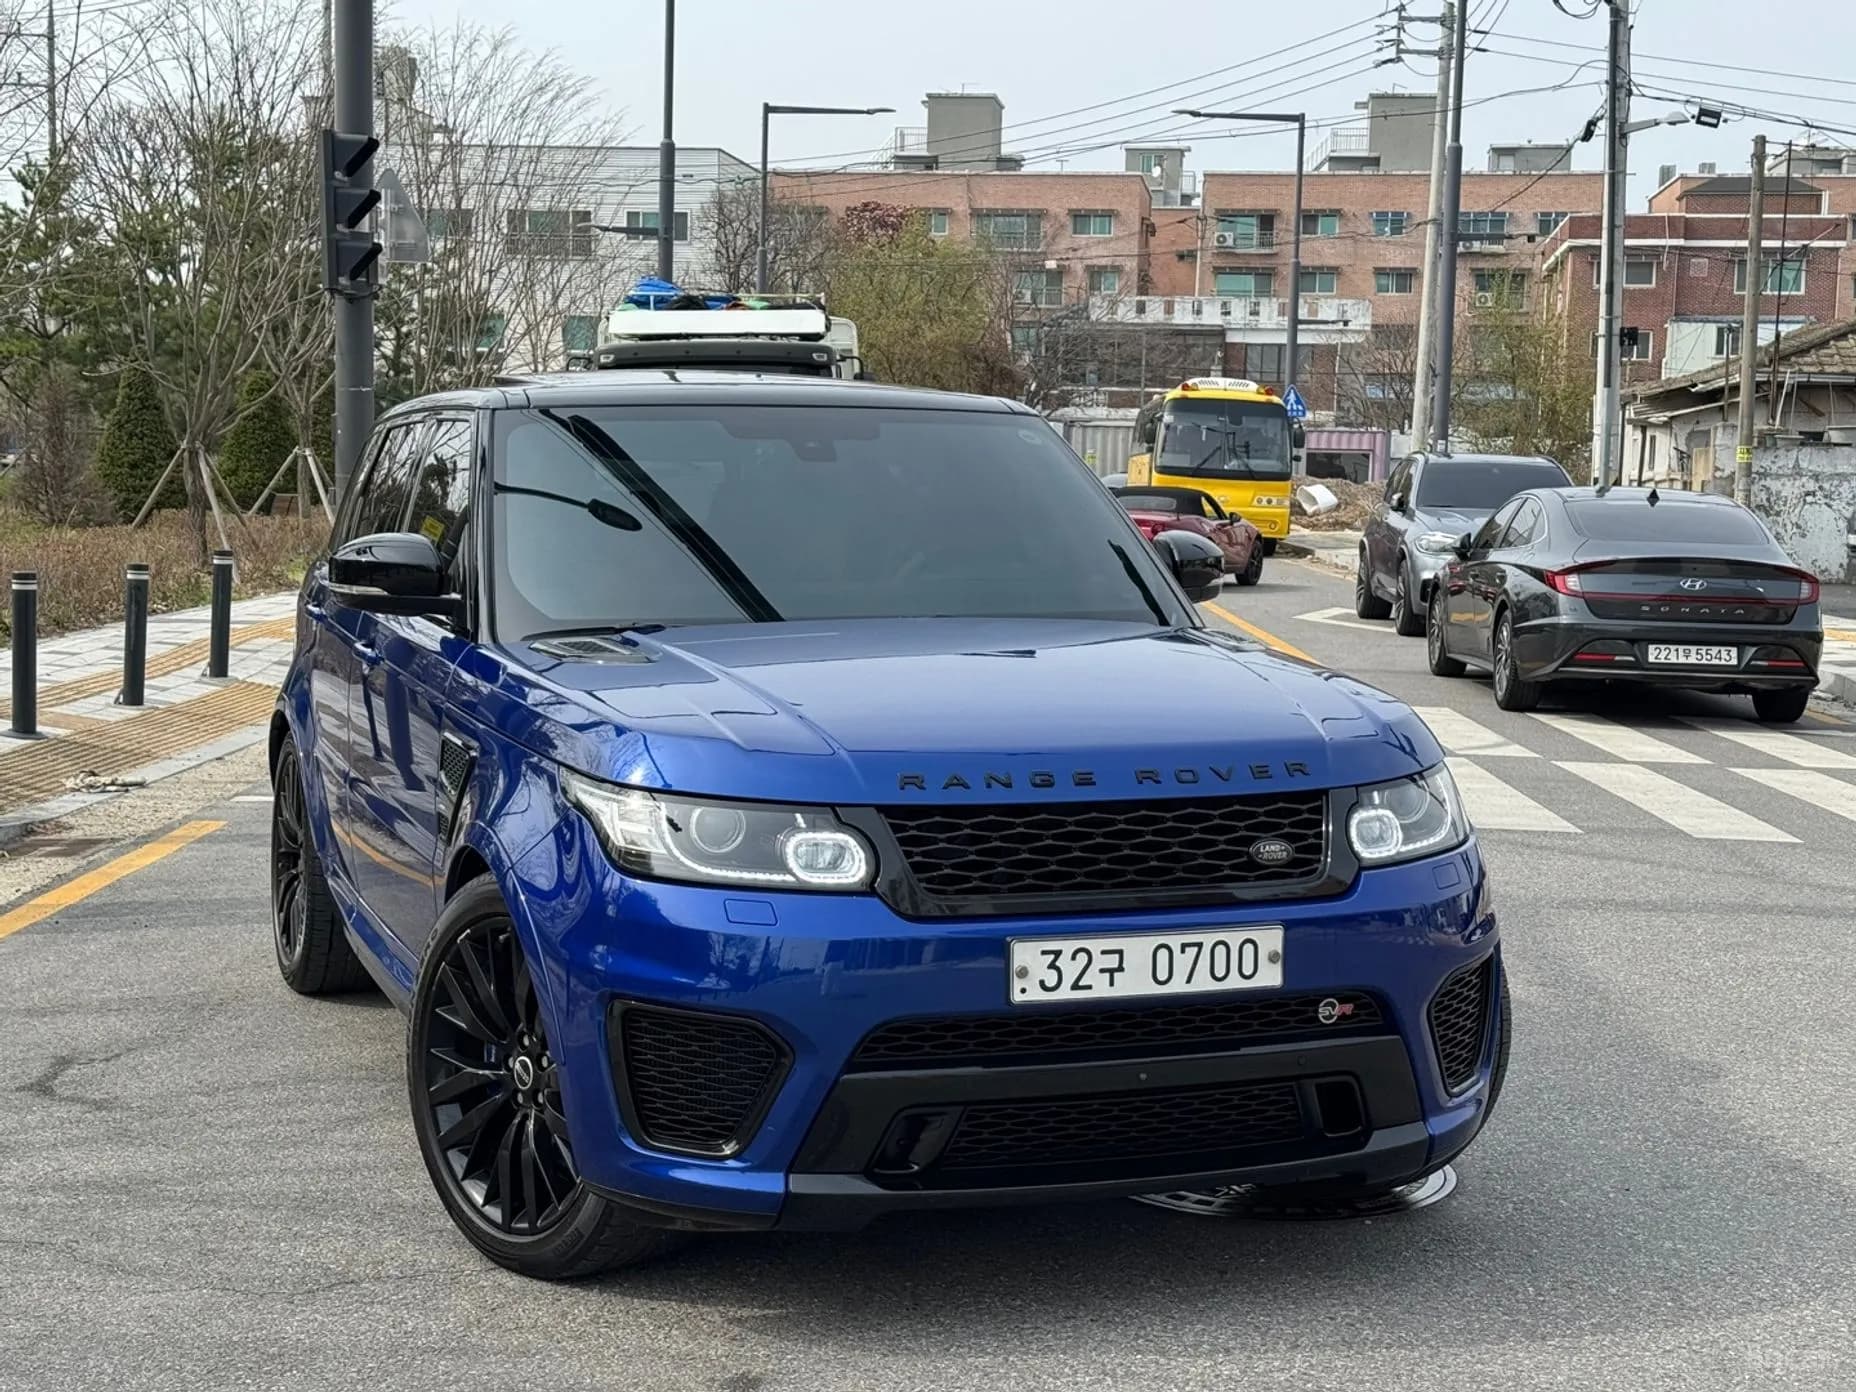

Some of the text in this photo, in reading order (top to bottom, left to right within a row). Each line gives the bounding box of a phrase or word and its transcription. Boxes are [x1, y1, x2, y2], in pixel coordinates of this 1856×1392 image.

[1640, 605, 1745, 615] SONATA
[898, 761, 1311, 791] RANGE ROVER
[1038, 938, 1259, 993] 32구 0700
